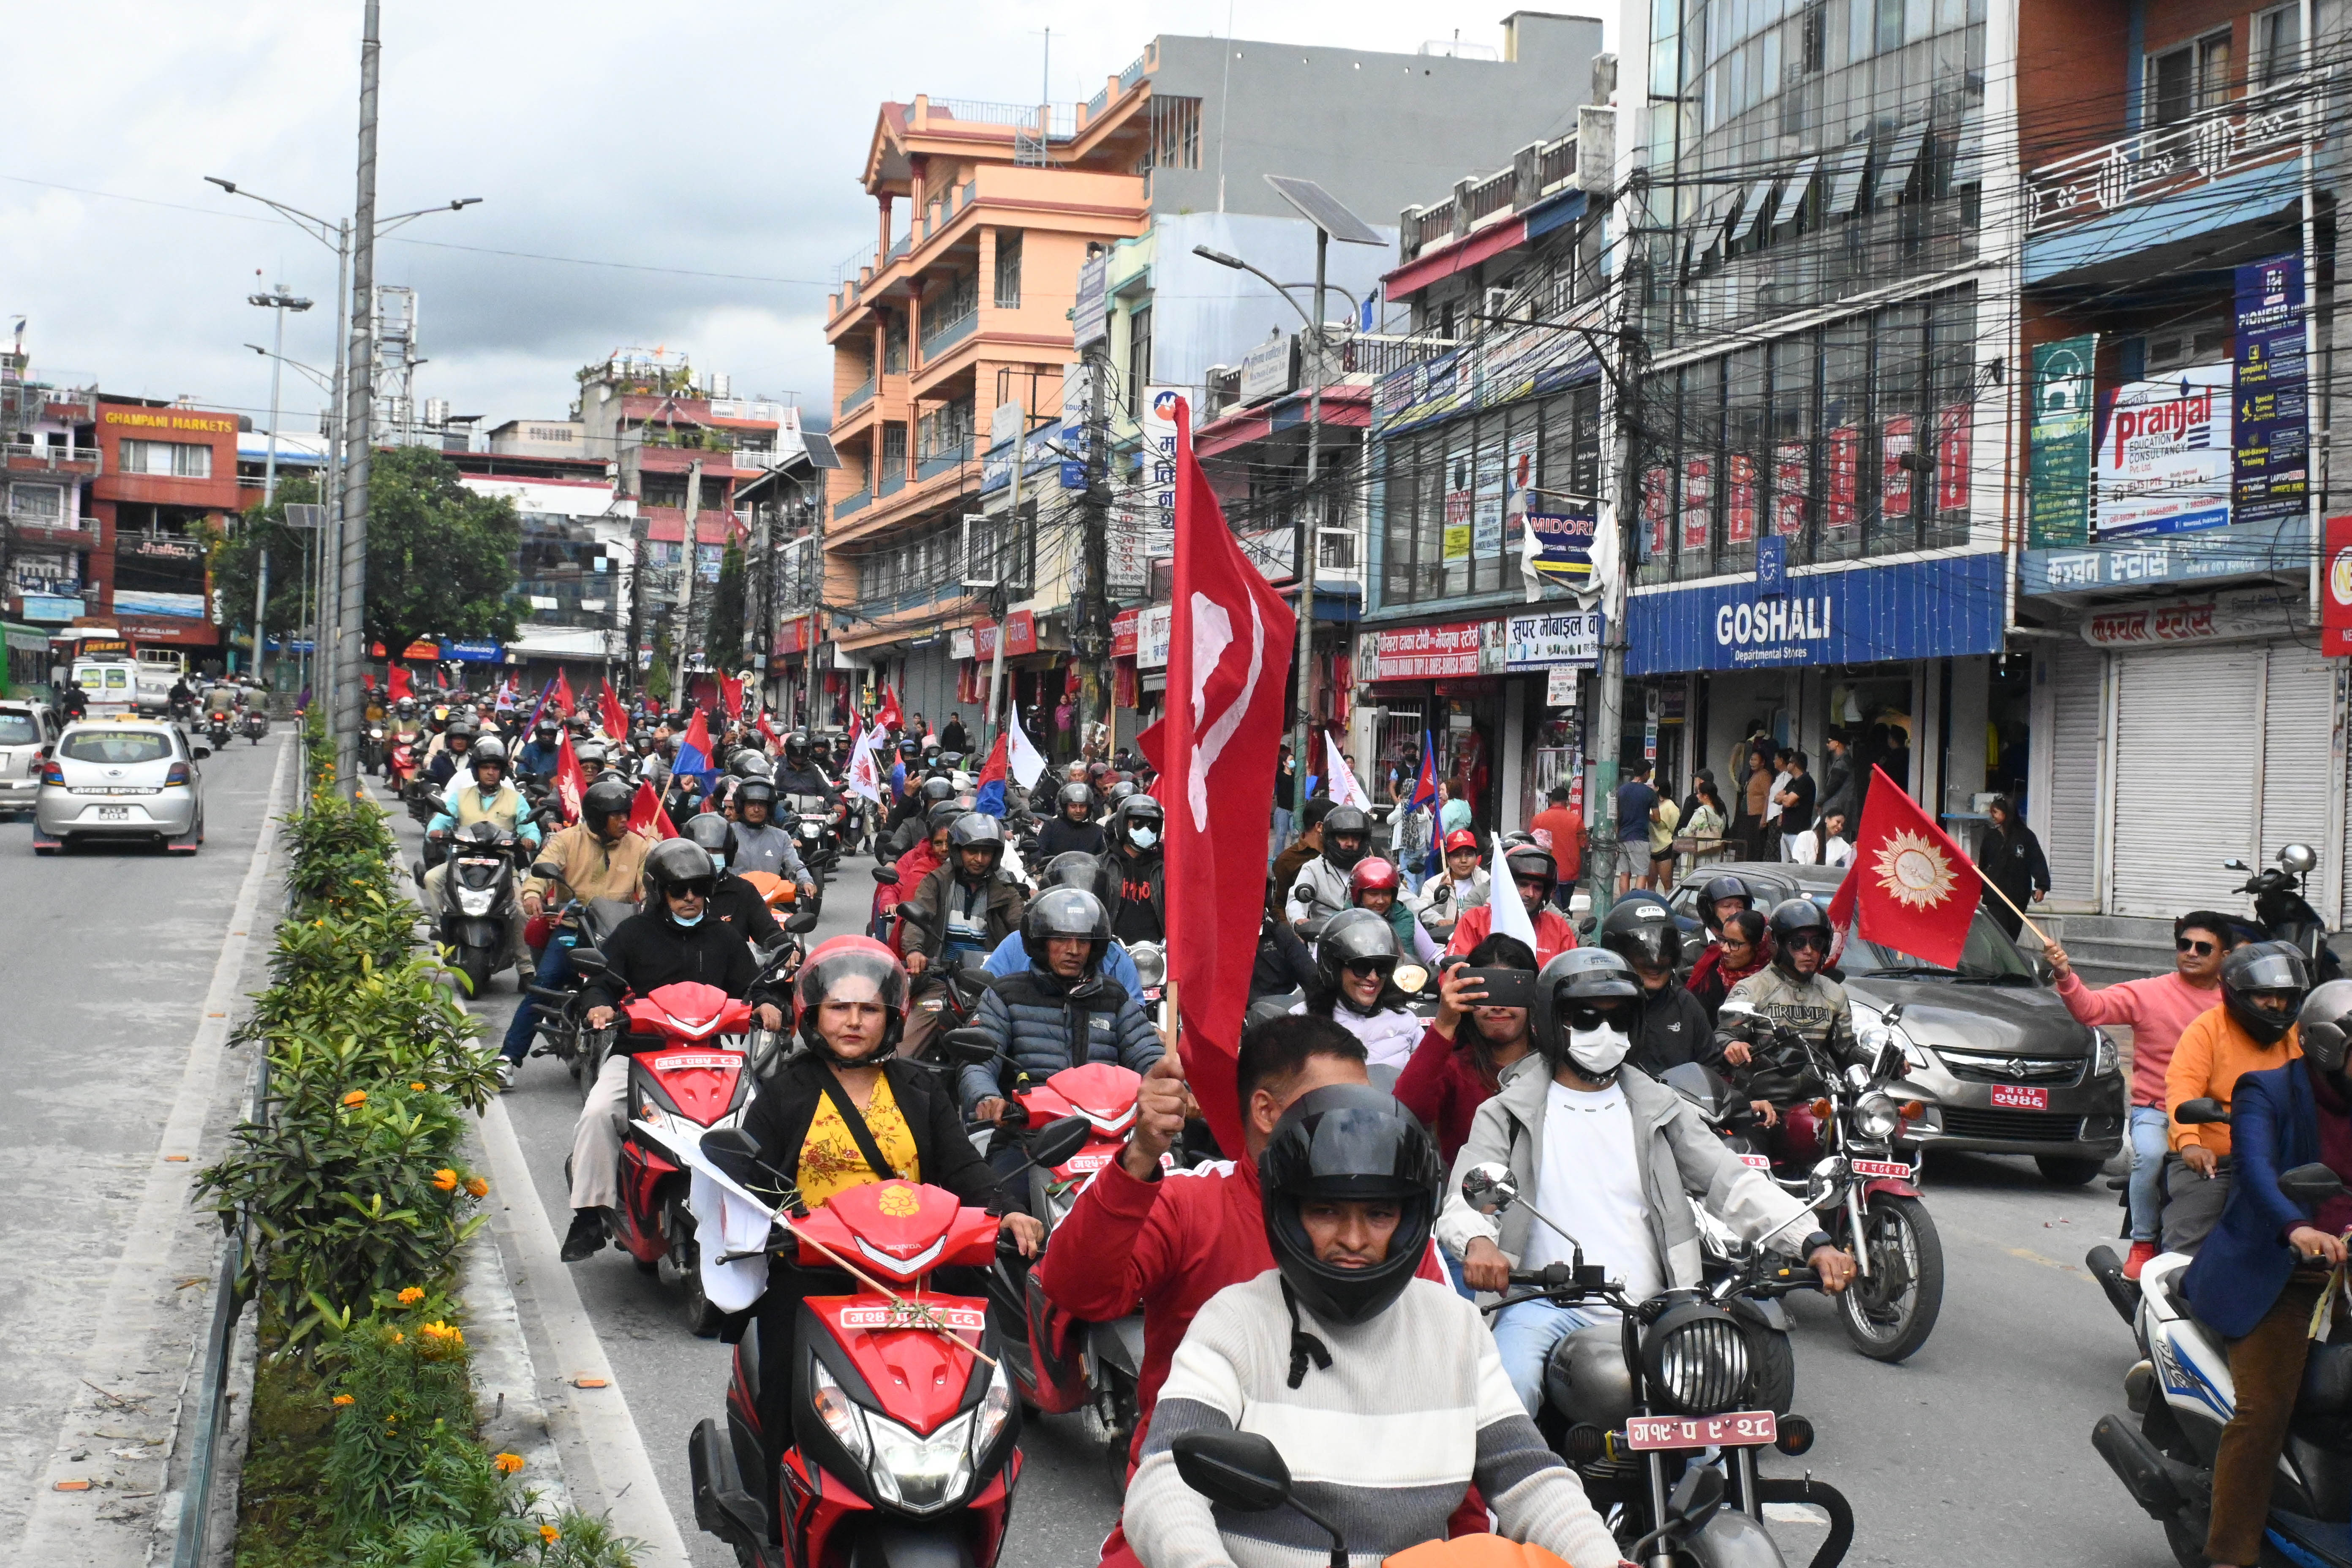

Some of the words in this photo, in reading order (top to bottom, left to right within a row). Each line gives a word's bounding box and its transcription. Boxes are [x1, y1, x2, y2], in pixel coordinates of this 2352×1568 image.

[105, 412, 168, 427] GHAMPANI
[172, 417, 233, 433] MARKETS
[2129, 434, 2171, 452] EDUCATION
[2129, 442, 2186, 464] CONSULTANCY
[2242, 457, 2265, 467] Training
[1531, 517, 1594, 536] MIDORI
[1513, 619, 1537, 645] सुपर
[1540, 612, 1584, 639] मोबाइल,
[1717, 596, 1831, 645] GOSHALI
[1380, 632, 1399, 652] पोखरा
[1399, 634, 1416, 651] ढाका
[1416, 628, 1430, 650] टोपी
[1735, 649, 1782, 663] Departmental
[1783, 647, 1807, 659] Stores
[1379, 659, 1398, 677] POKHARA
[1399, 658, 1414, 675] DHAKA
[1414, 658, 1424, 675] TOPI
[1459, 654, 1478, 674] STORES
[1995, 1094, 2043, 1108] २५४६
[1681, 1420, 1697, 1439] प
